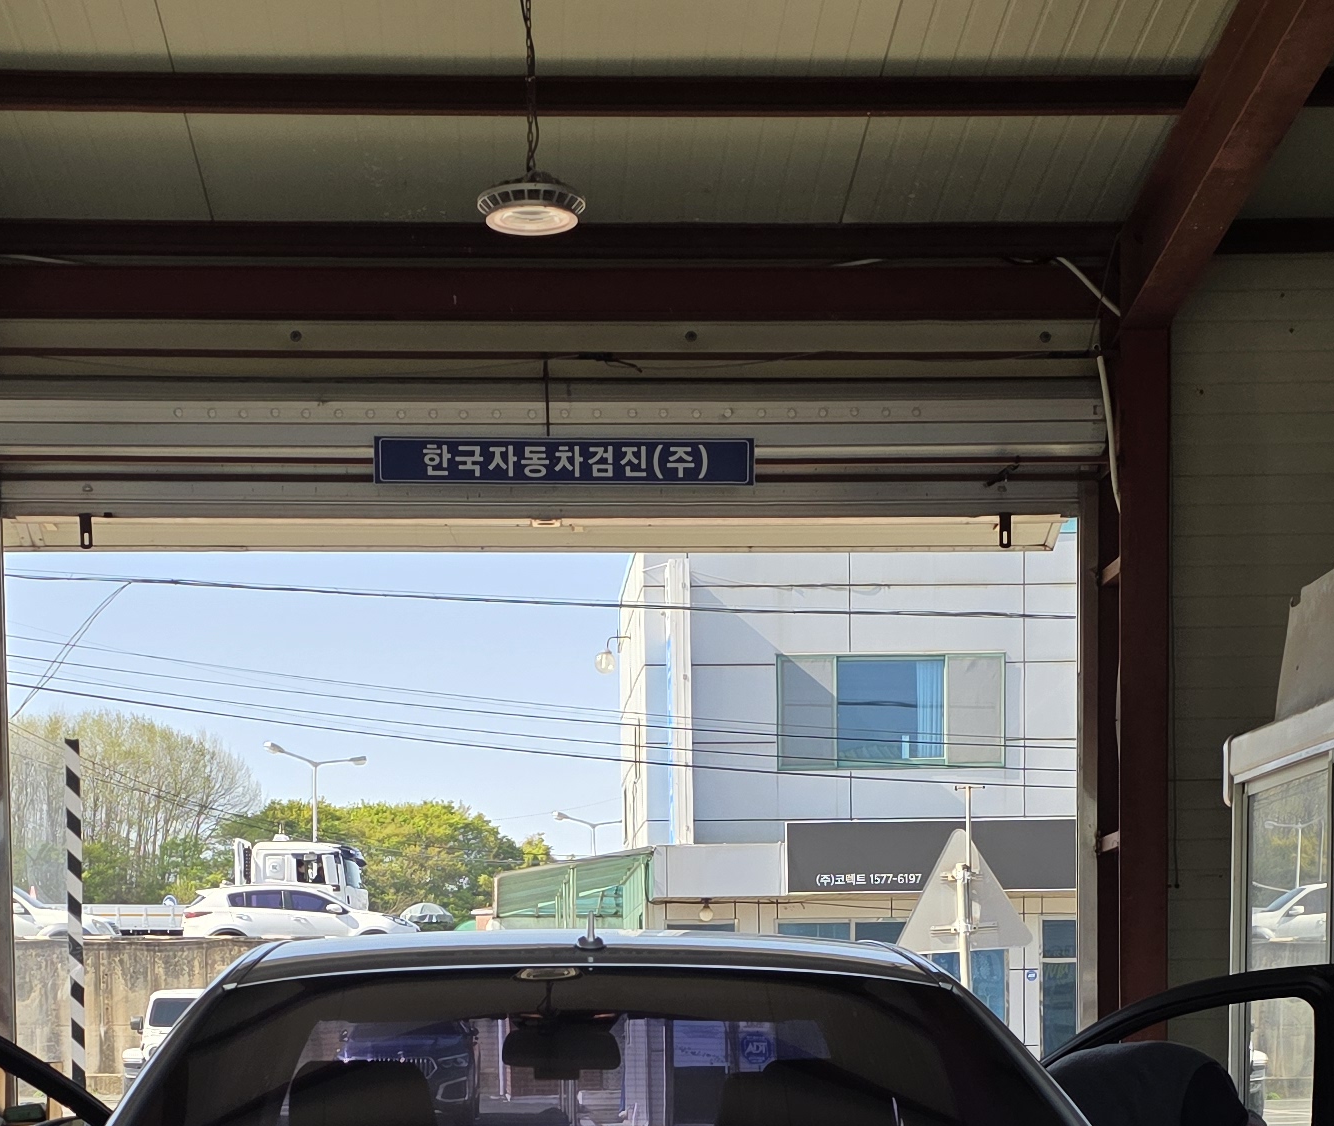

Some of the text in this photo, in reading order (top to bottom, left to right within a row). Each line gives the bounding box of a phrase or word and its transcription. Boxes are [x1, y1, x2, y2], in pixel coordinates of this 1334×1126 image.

[422, 443, 709, 479] 한국자동차검진(주)
[869, 873, 922, 885] 1577-6197
[744, 1041, 767, 1056] ADT
